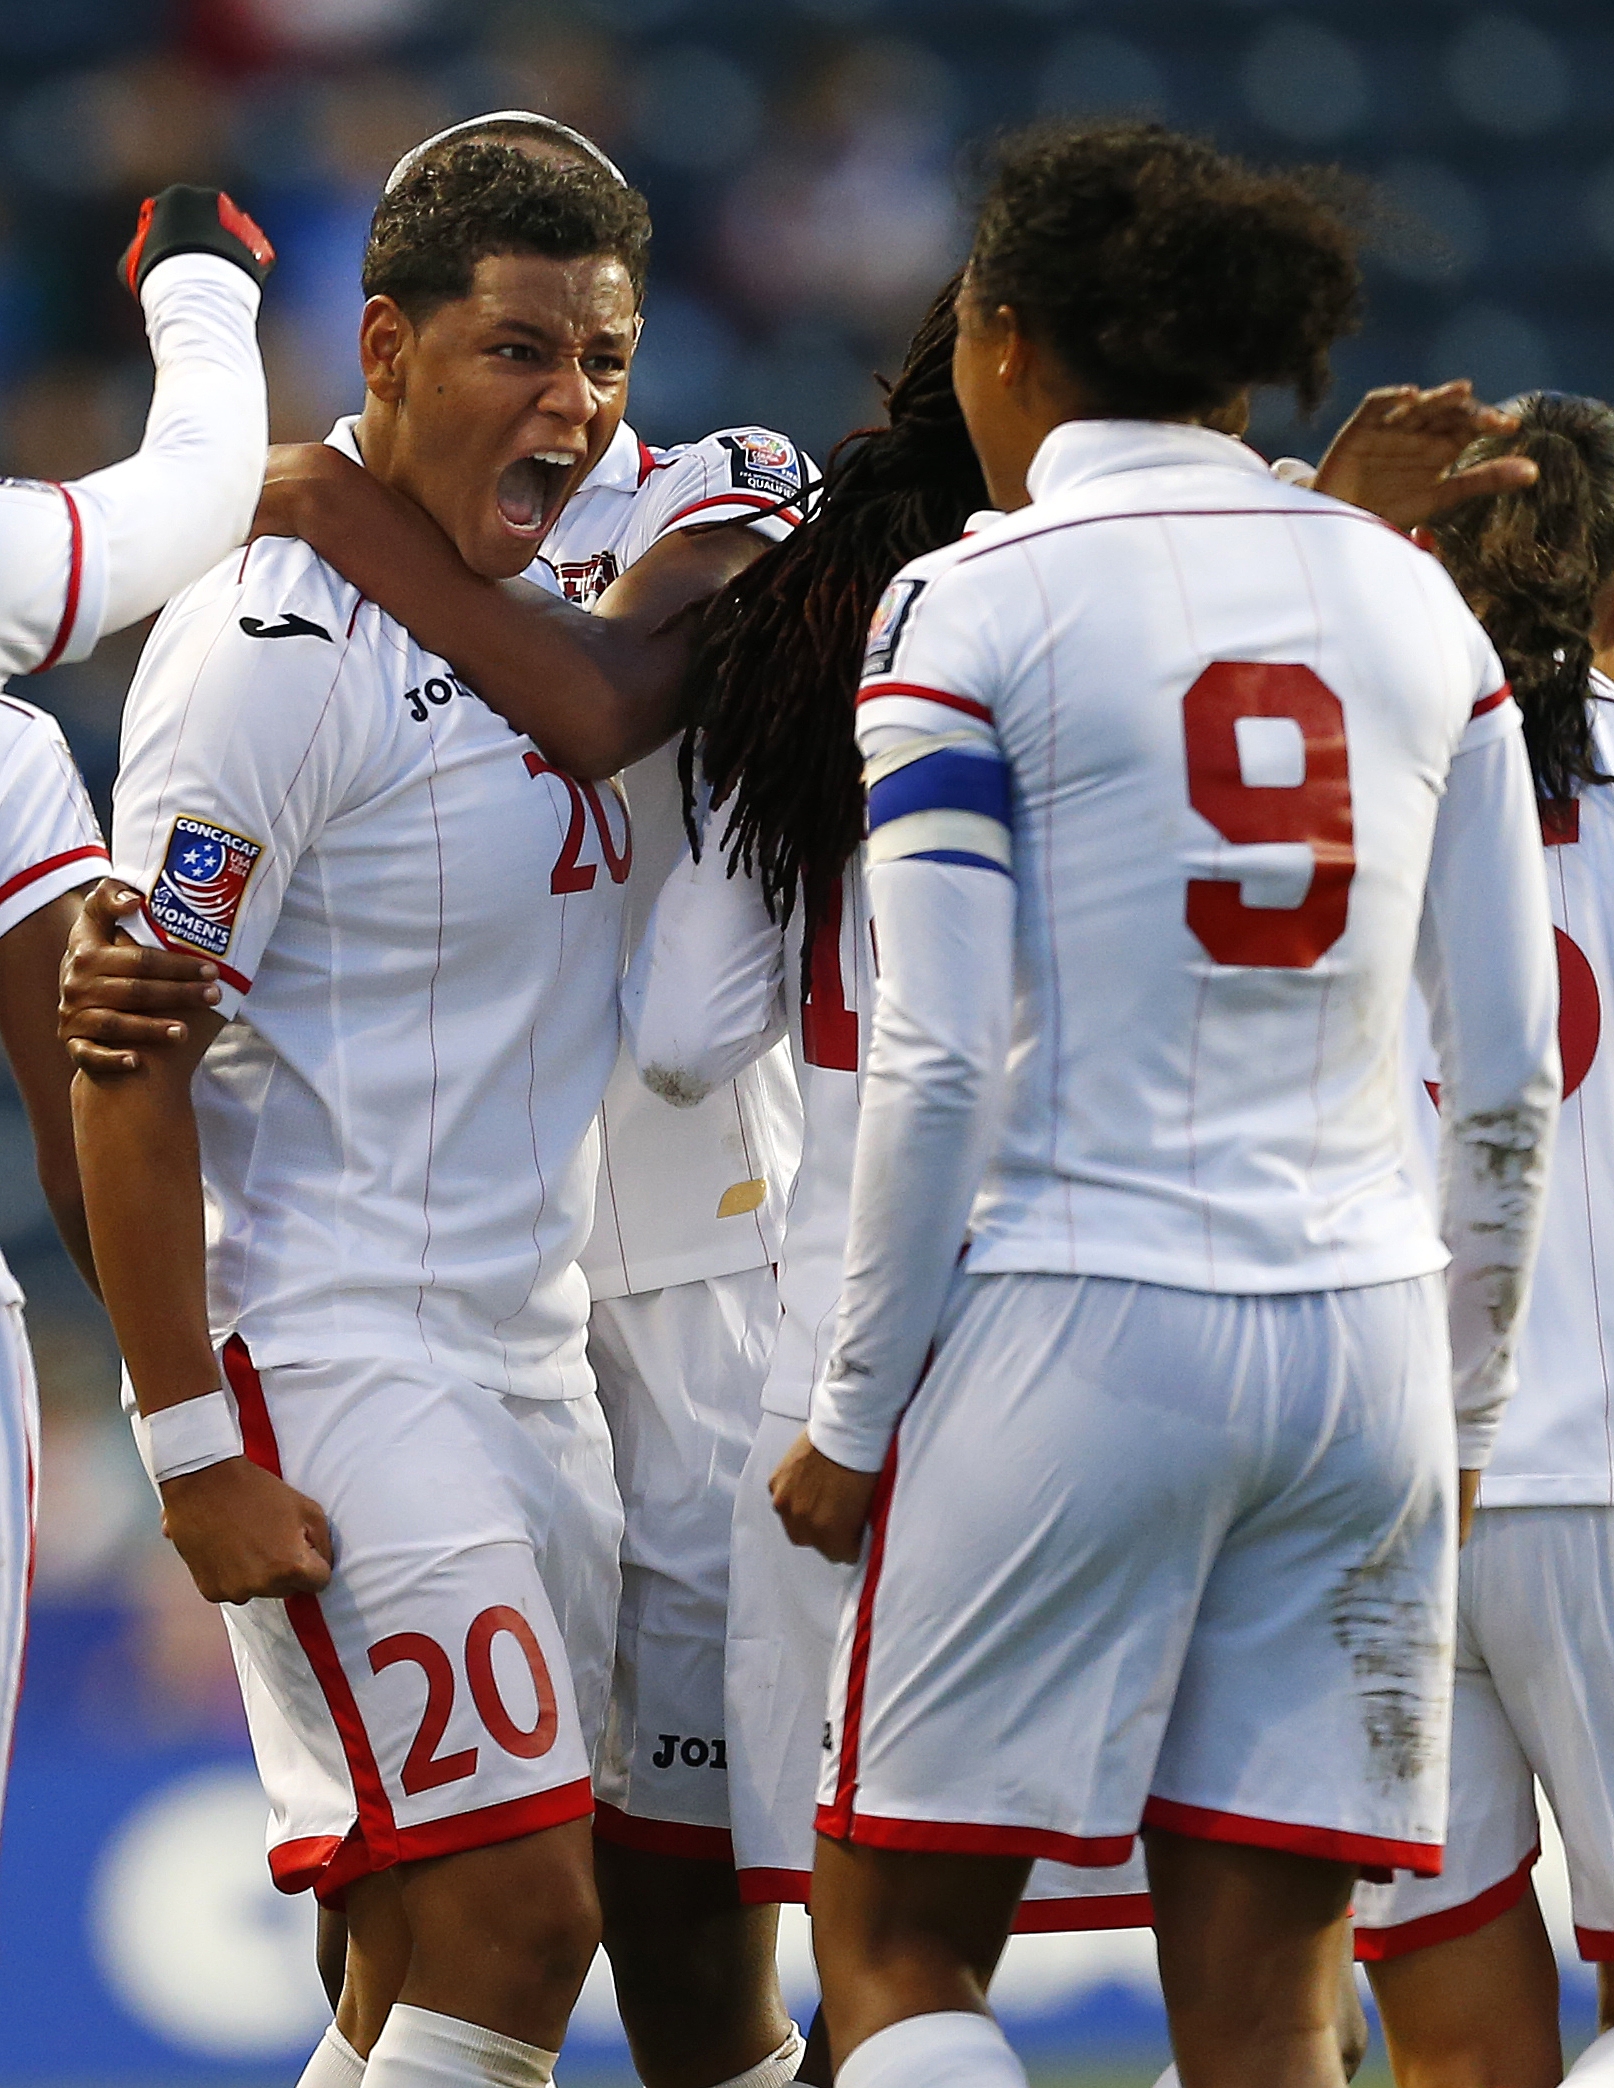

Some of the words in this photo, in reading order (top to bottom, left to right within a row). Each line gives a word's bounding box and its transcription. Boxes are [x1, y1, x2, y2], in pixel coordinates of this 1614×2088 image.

[747, 477, 798, 499] QUALIFIE
[521, 751, 632, 895] 20
[1182, 661, 1356, 968] 9
[176, 818, 260, 858] CONCACAF
[151, 901, 230, 945] WOMEN'S
[152, 914, 226, 953] AMPIONSHIP
[367, 1604, 558, 1797] 20
